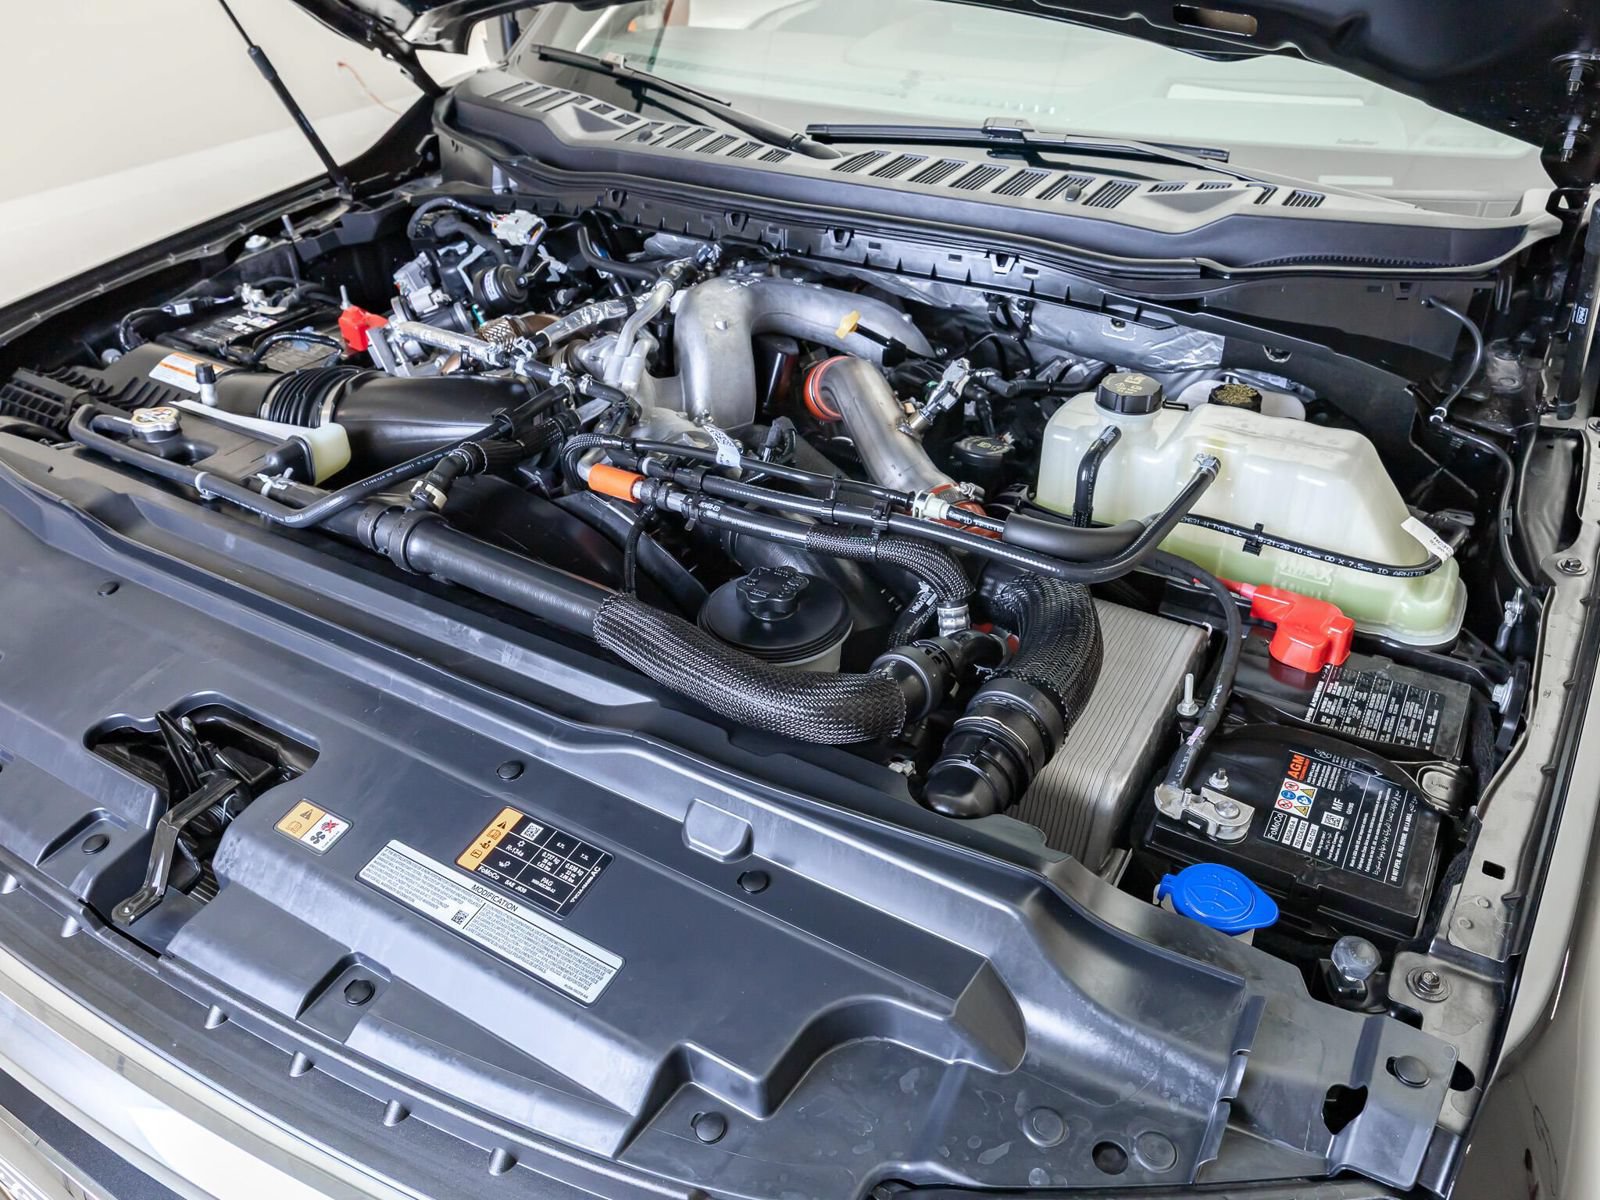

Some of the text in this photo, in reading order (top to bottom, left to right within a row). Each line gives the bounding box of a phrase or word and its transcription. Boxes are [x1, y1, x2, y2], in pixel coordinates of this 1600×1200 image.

[1348, 560, 1373, 572] 7.5mm
[1377, 567, 1389, 575] ID
[1287, 754, 1305, 778] AGM
[1331, 797, 1345, 812] MF
[1267, 812, 1284, 839] FoMoCo
[505, 845, 525, 857] R-134a
[477, 865, 501, 881] FoMoCo
[504, 879, 516, 888] SAE
[540, 877, 554, 887] PAG
[471, 883, 519, 912] MODIFICATION
